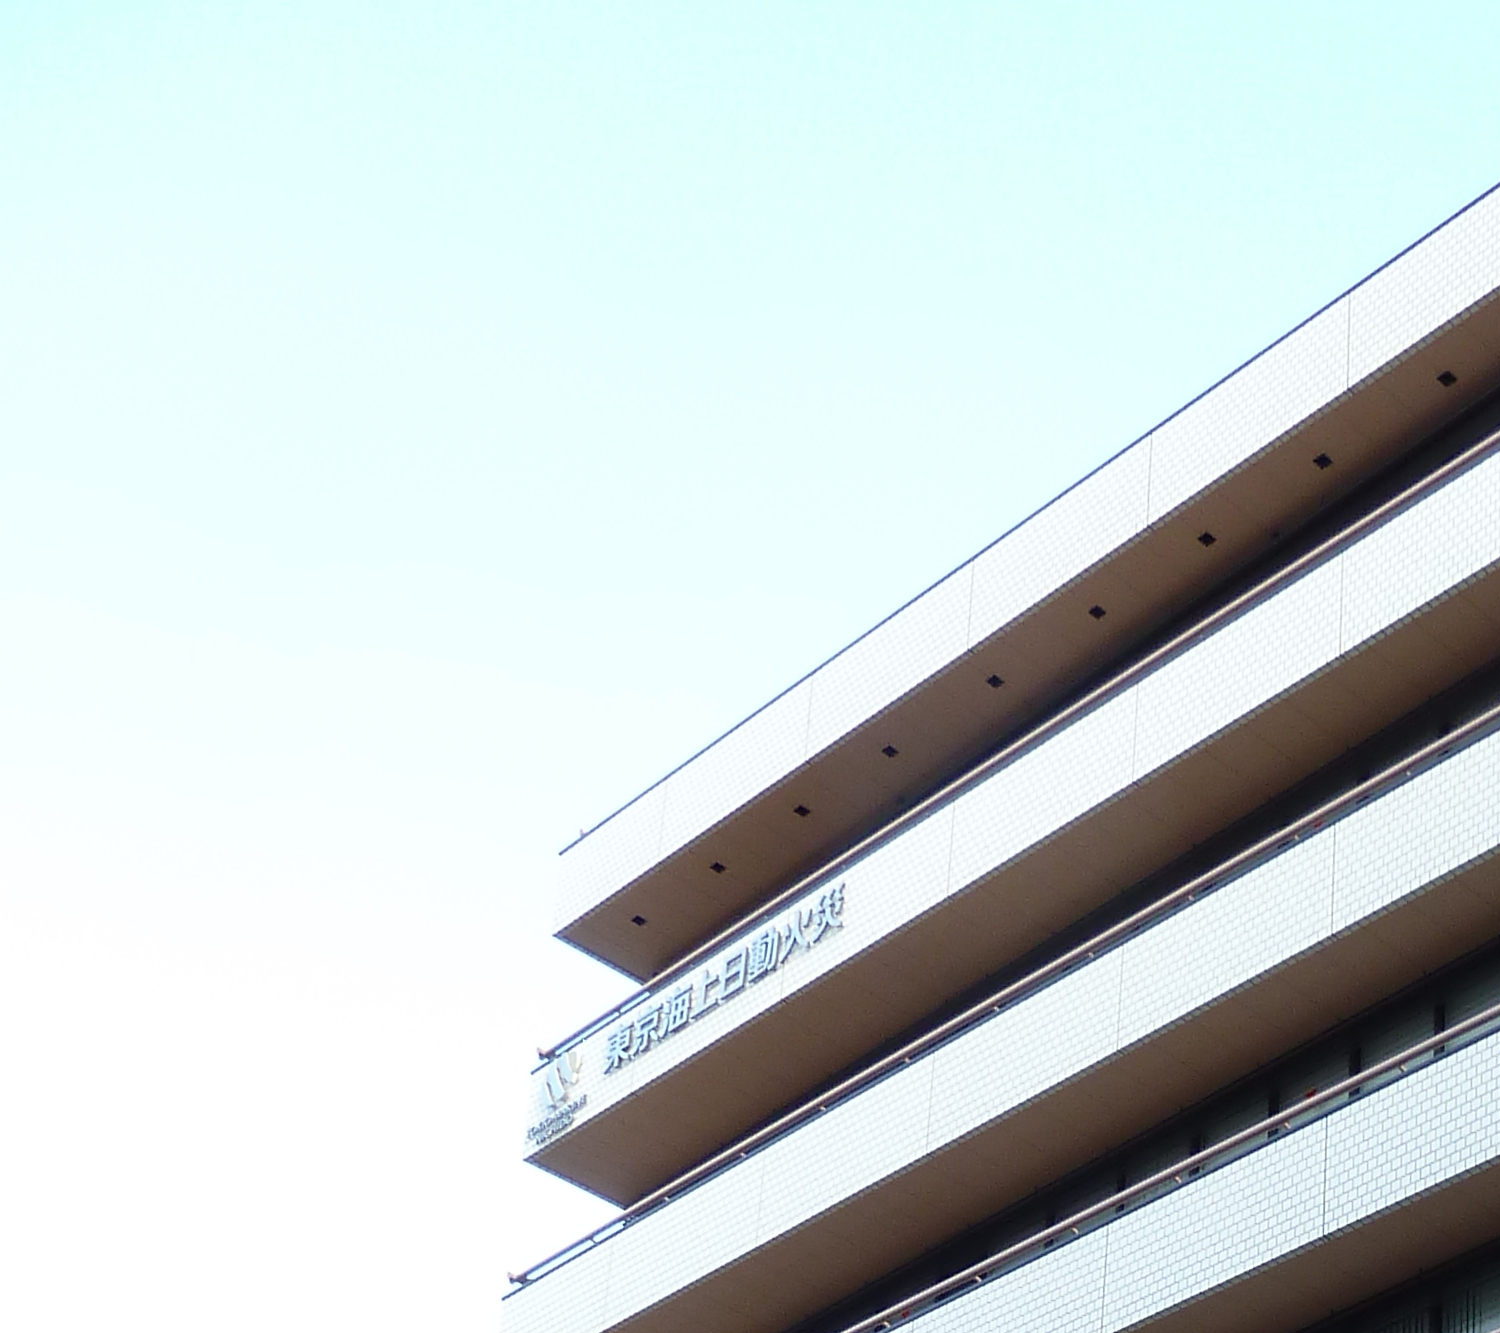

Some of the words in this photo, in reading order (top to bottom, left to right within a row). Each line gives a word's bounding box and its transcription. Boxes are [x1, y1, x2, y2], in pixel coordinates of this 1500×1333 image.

[603, 882, 847, 1075] 東京海上日動火災
